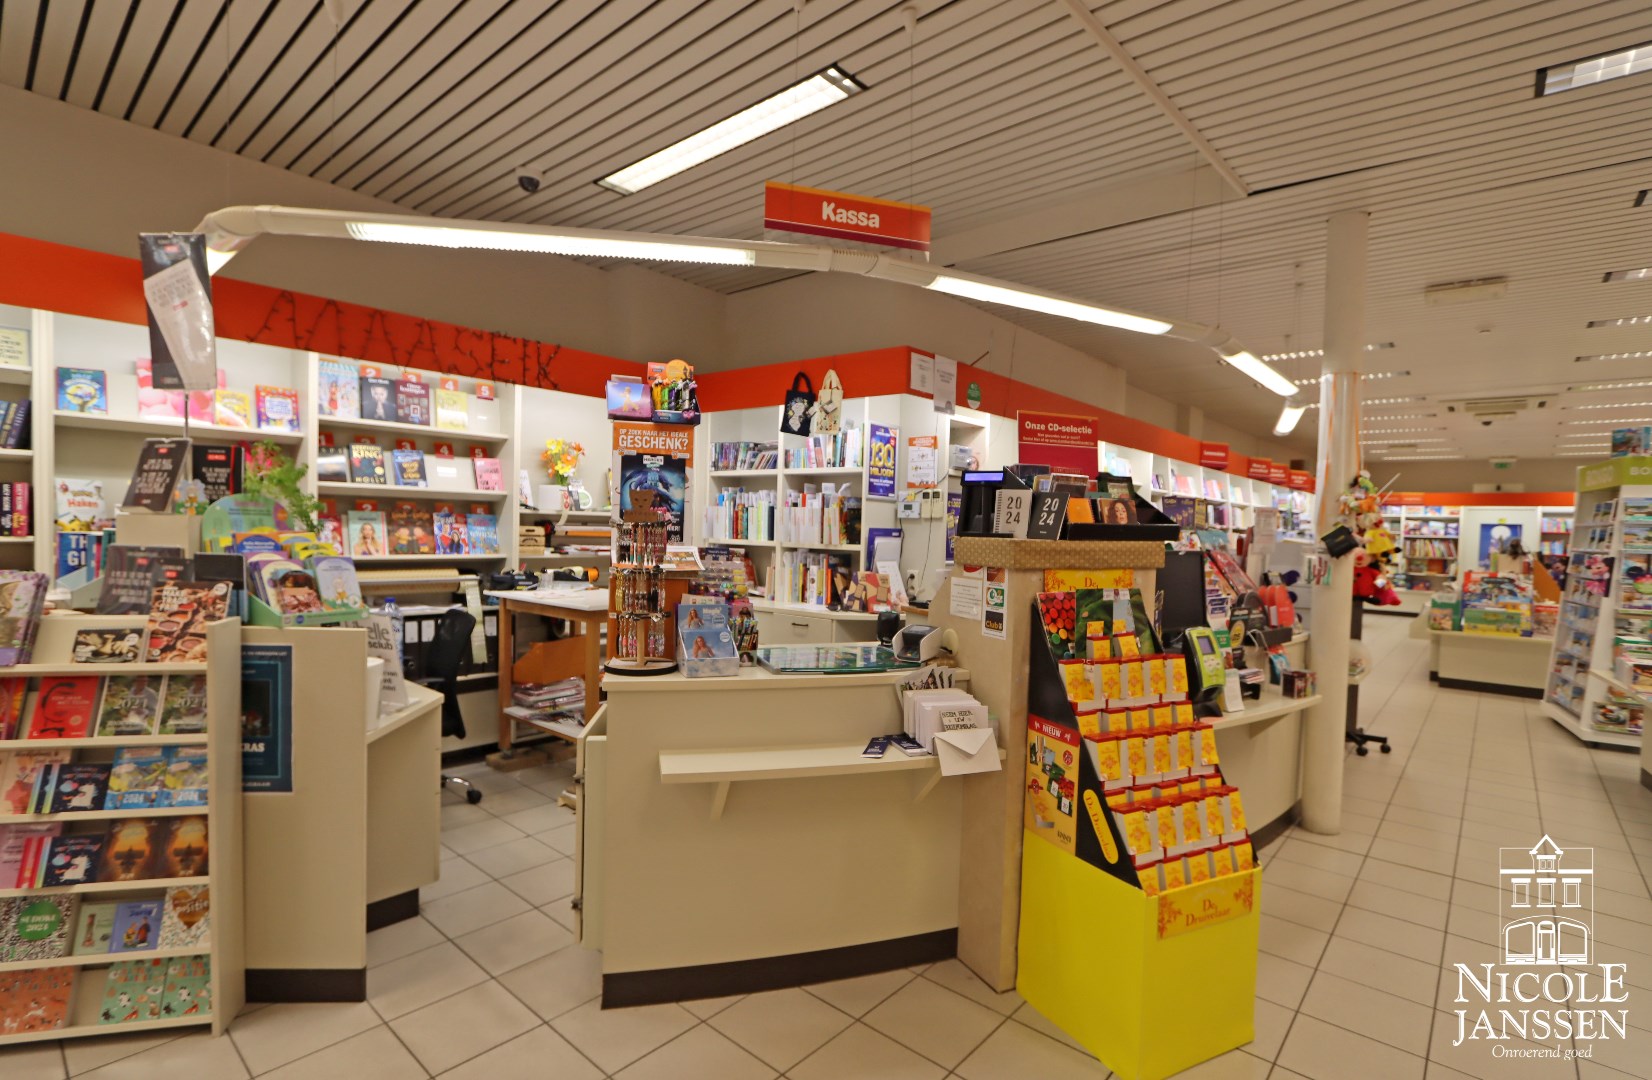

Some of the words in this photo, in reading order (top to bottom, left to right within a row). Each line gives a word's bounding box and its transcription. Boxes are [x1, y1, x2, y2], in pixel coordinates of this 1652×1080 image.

[822, 200, 880, 229] Kassa
[481, 385, 490, 397] 5
[1025, 420, 1045, 431] Onze
[1047, 422, 1093, 434] CD-selectie
[618, 435, 689, 450] GESCHENK?
[352, 450, 383, 459] KING
[1630, 466, 1652, 476] BO
[1007, 496, 1022, 510] 20
[1043, 497, 1060, 512] 20
[1005, 511, 1021, 525] 24
[1038, 512, 1056, 526] 24
[1202, 898, 1216, 912] De
[1185, 908, 1232, 927] Druivelaar
